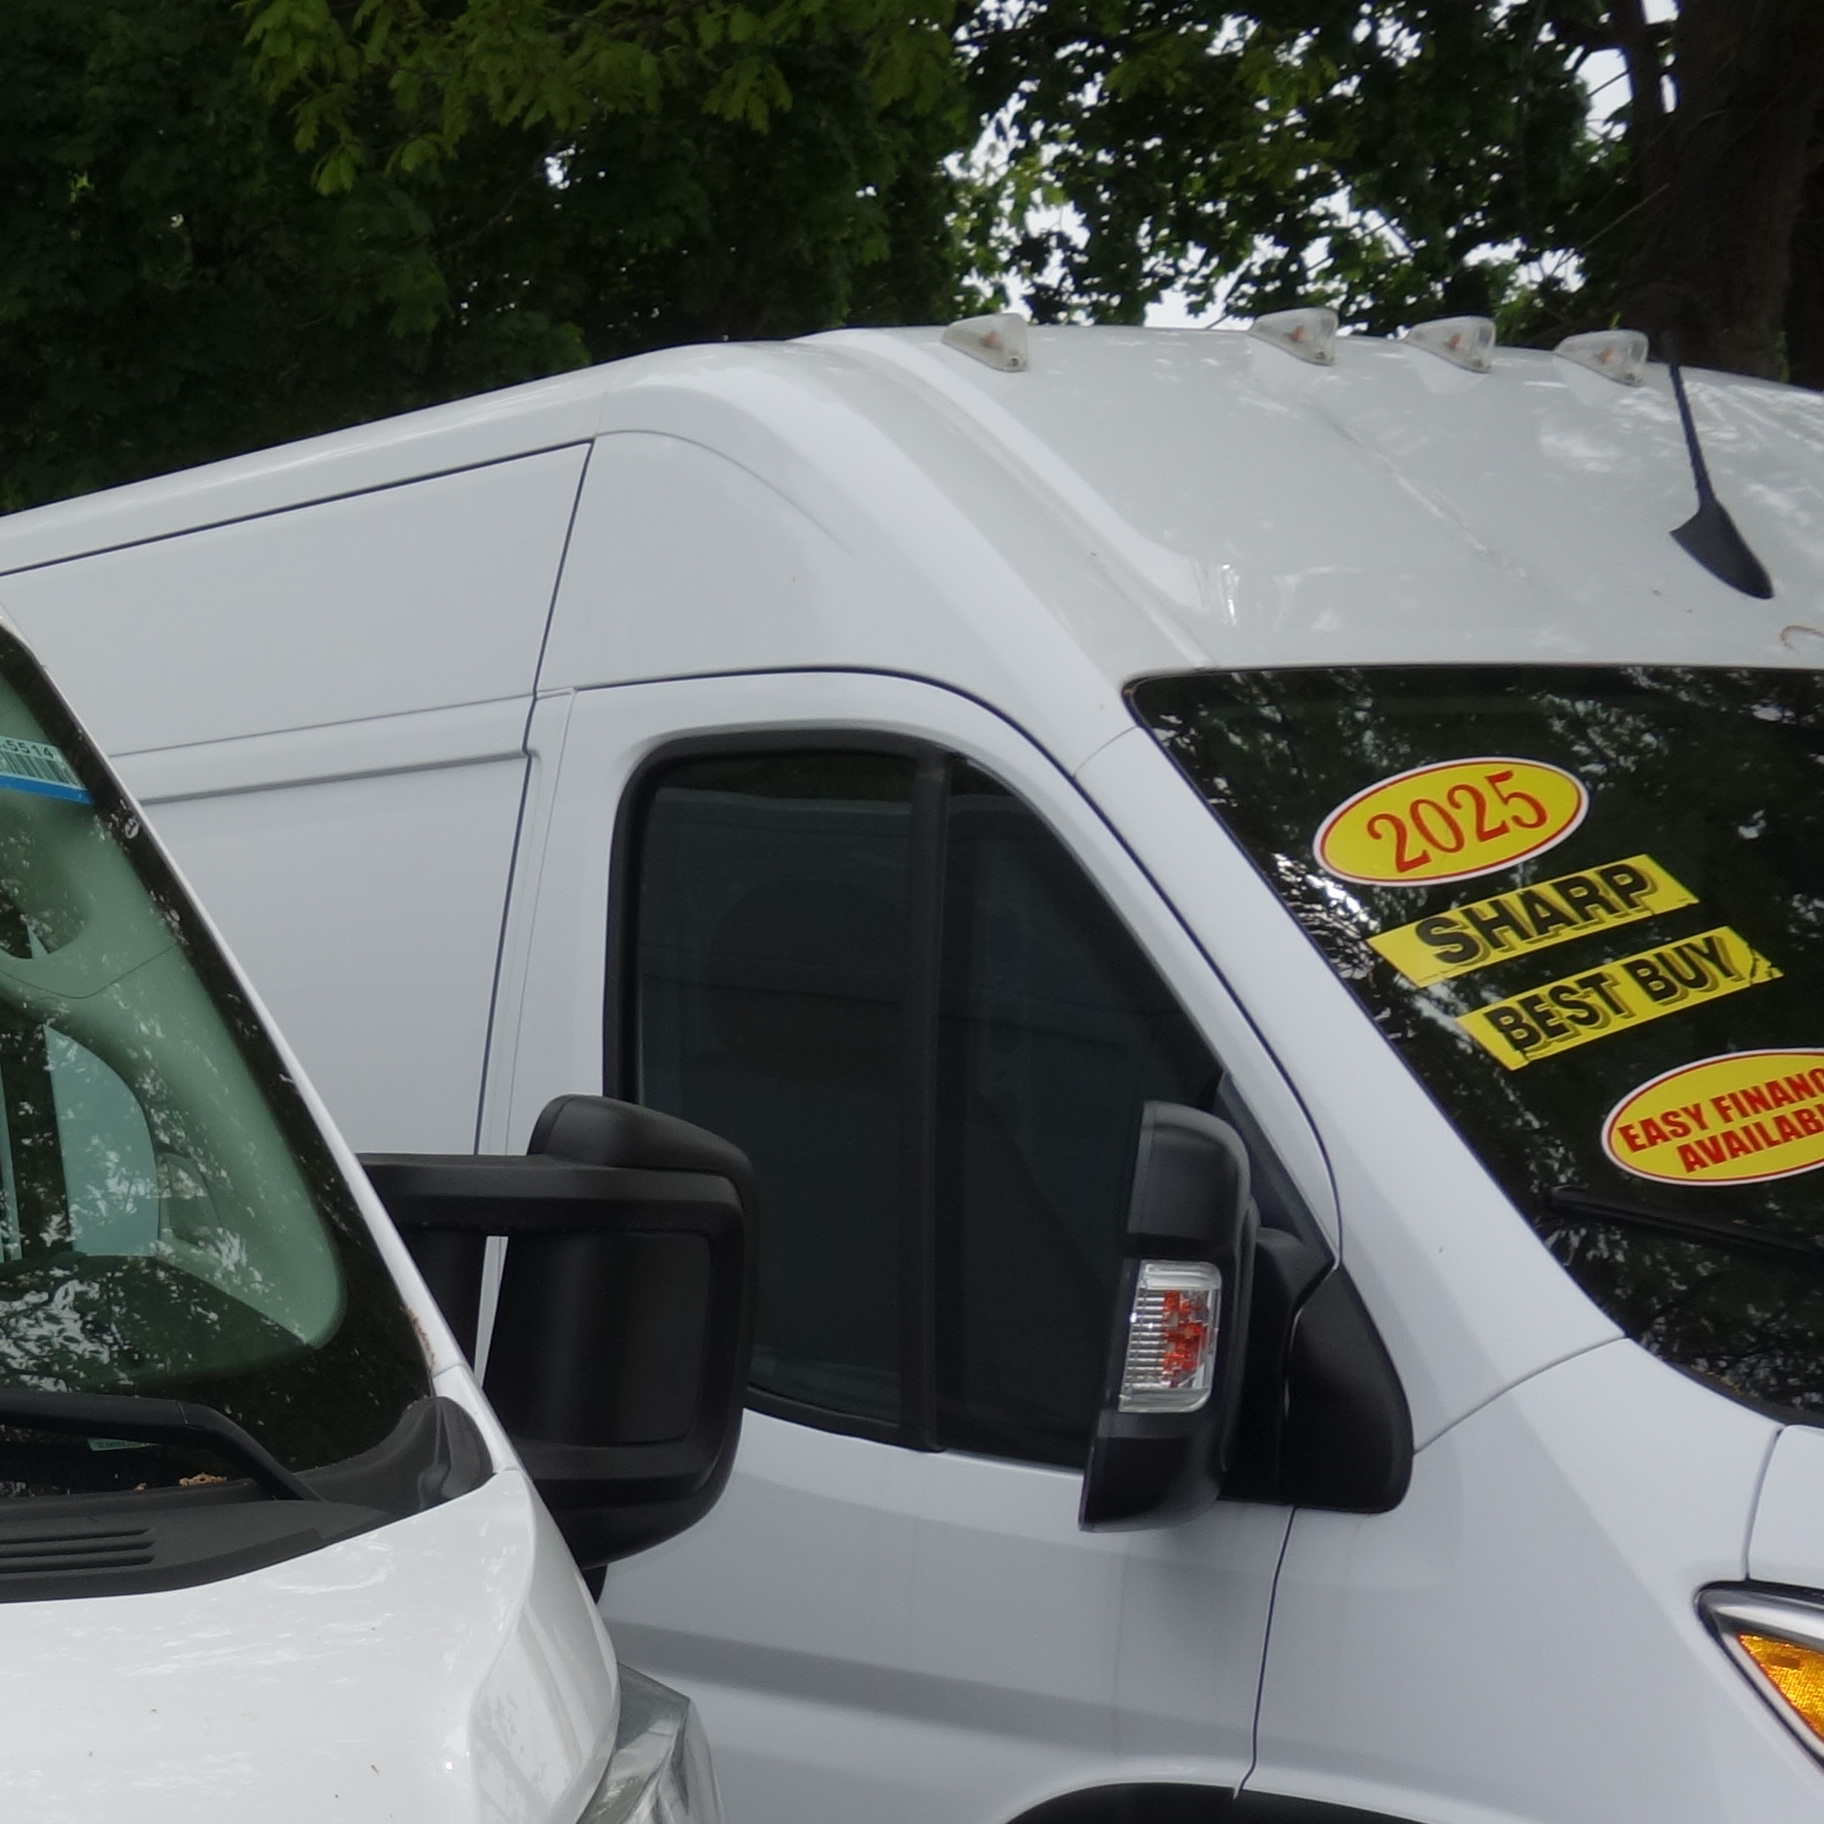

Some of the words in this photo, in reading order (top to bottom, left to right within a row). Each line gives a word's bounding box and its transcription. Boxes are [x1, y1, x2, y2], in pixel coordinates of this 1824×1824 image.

[6, 739, 54, 759] 5514
[1367, 769, 1548, 874] 2025
[1415, 863, 1656, 966] SHARP
[1483, 972, 1633, 1052] BEST
[1621, 934, 1743, 1004] BUY
[1617, 1102, 1710, 1154] EASY
